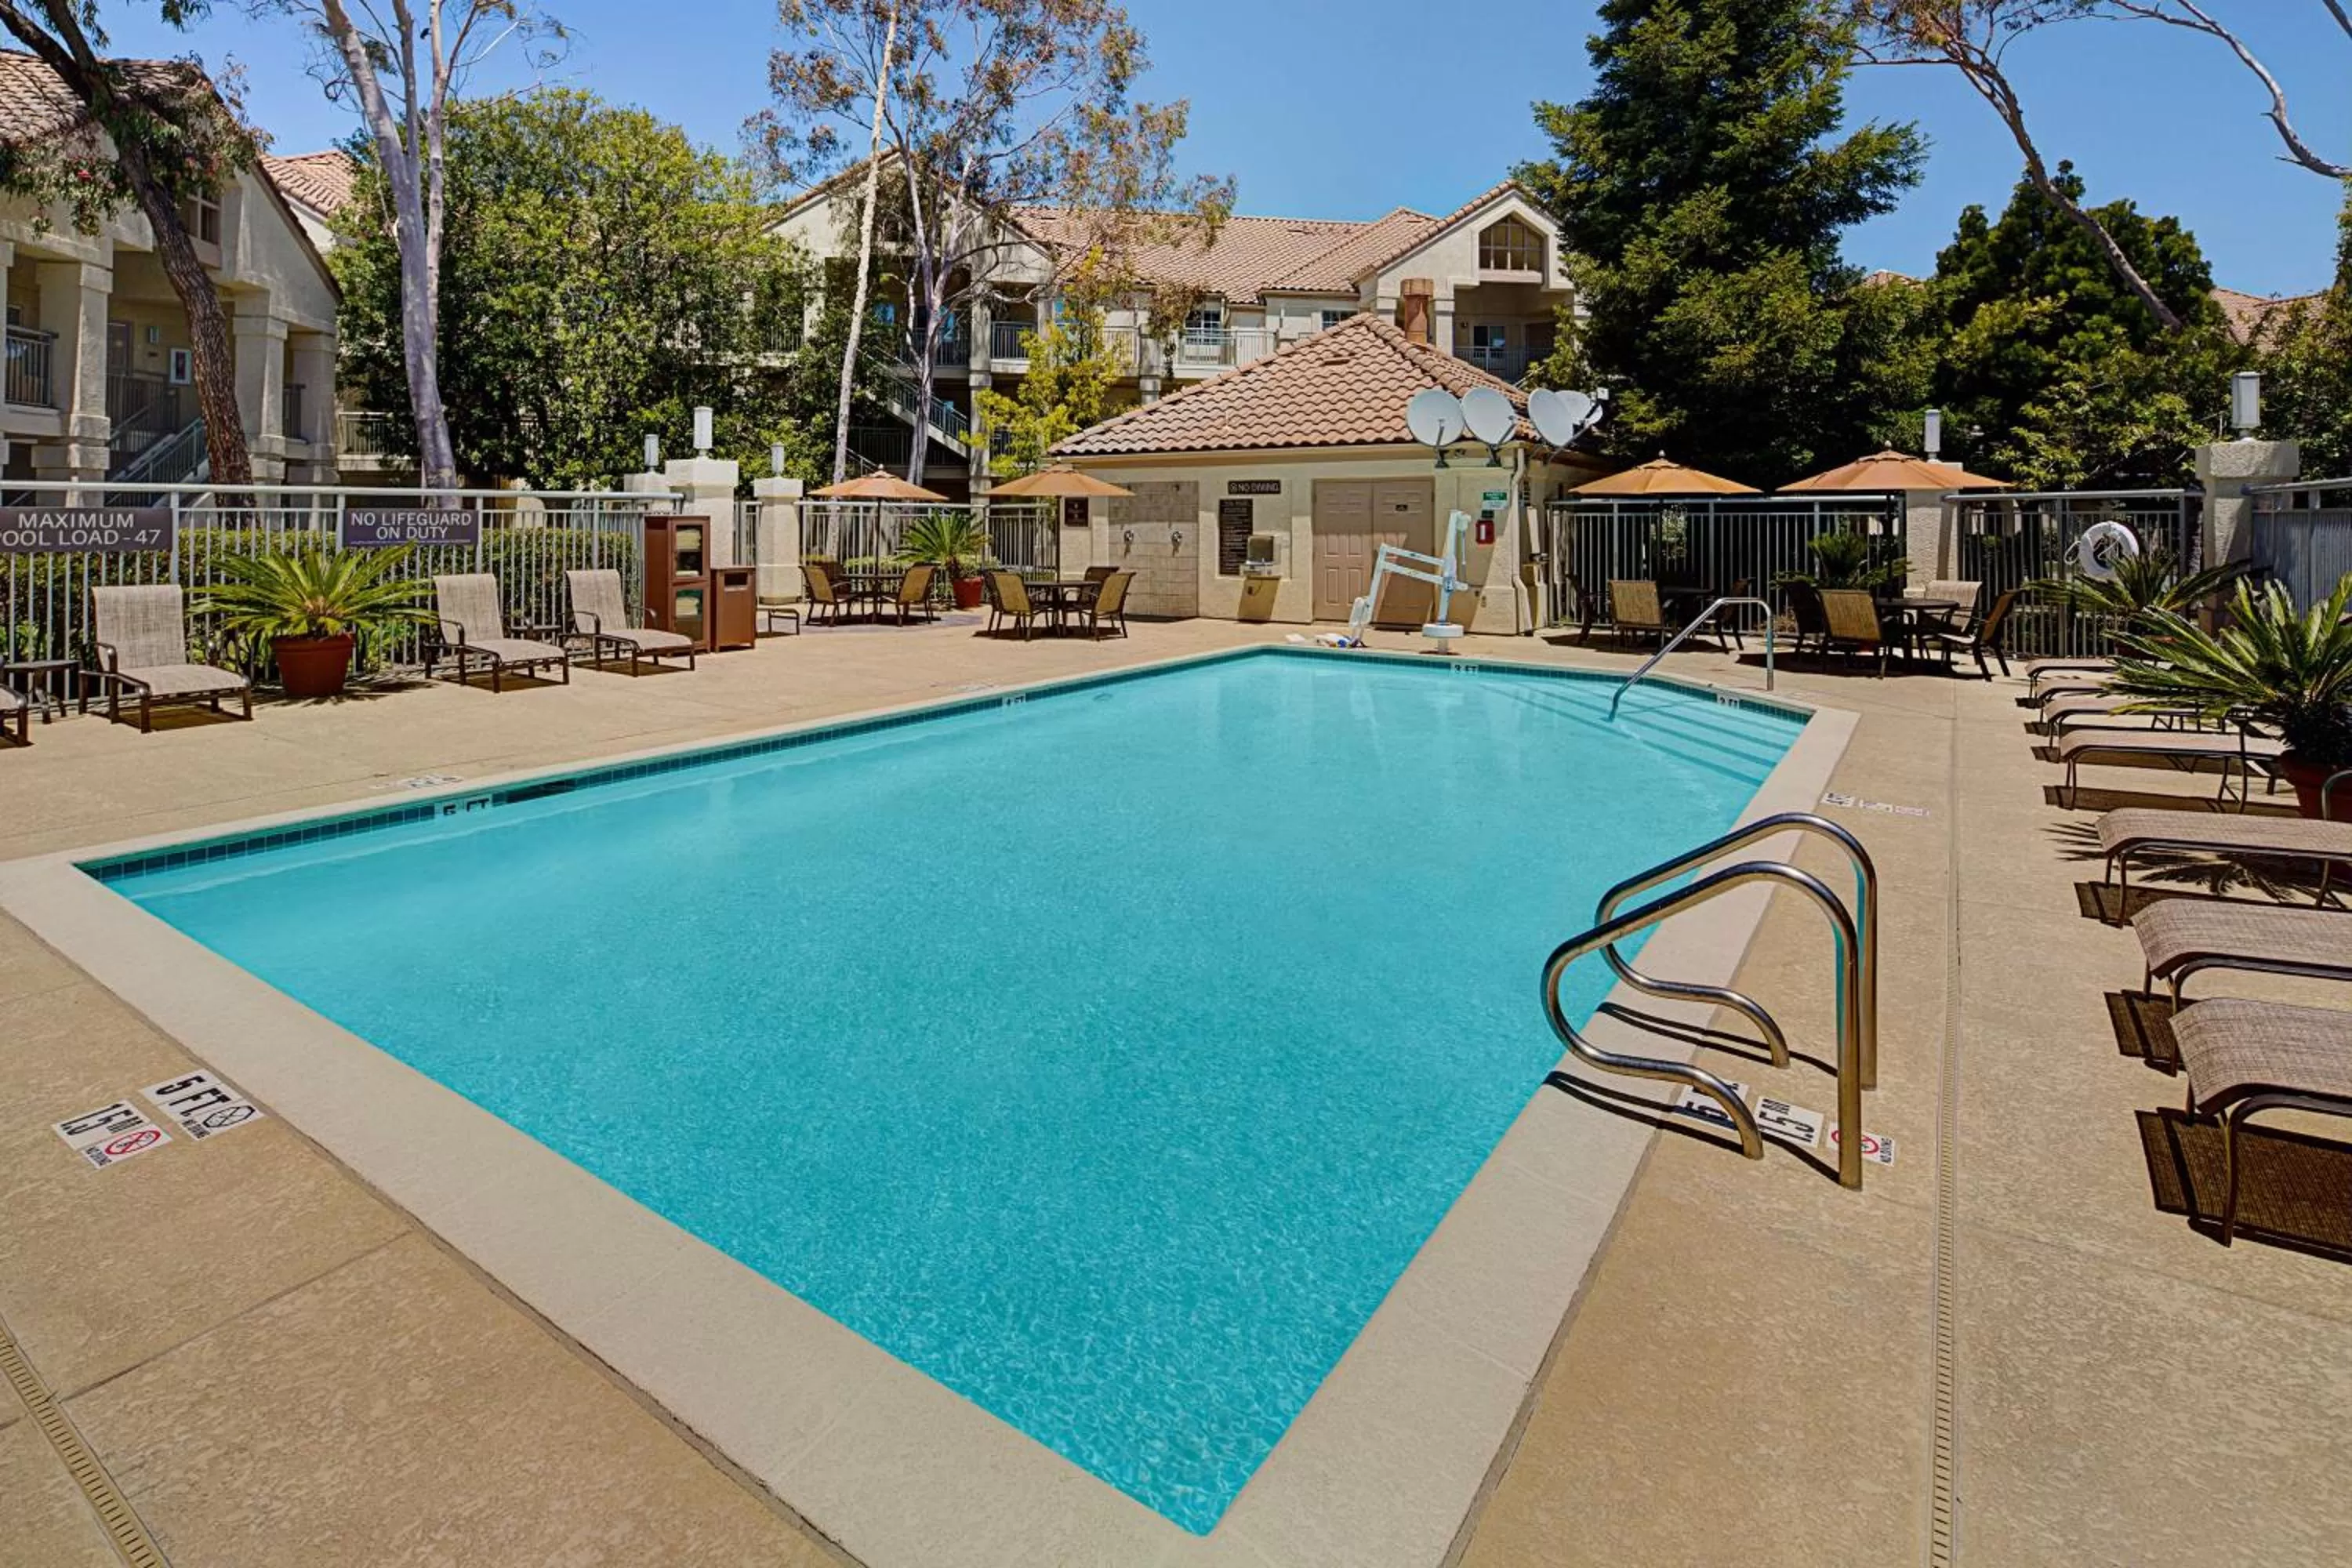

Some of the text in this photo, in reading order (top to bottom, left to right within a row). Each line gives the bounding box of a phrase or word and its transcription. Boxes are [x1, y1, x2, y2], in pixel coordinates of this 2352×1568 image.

[18, 514, 134, 528] MAXIMUM
[351, 512, 471, 525] NO LIFEGUARD
[0, 530, 51, 546] OOL
[376, 526, 448, 539] ON DUTY
[156, 1075, 205, 1095] 5
[60, 1103, 133, 1136] 1.5
